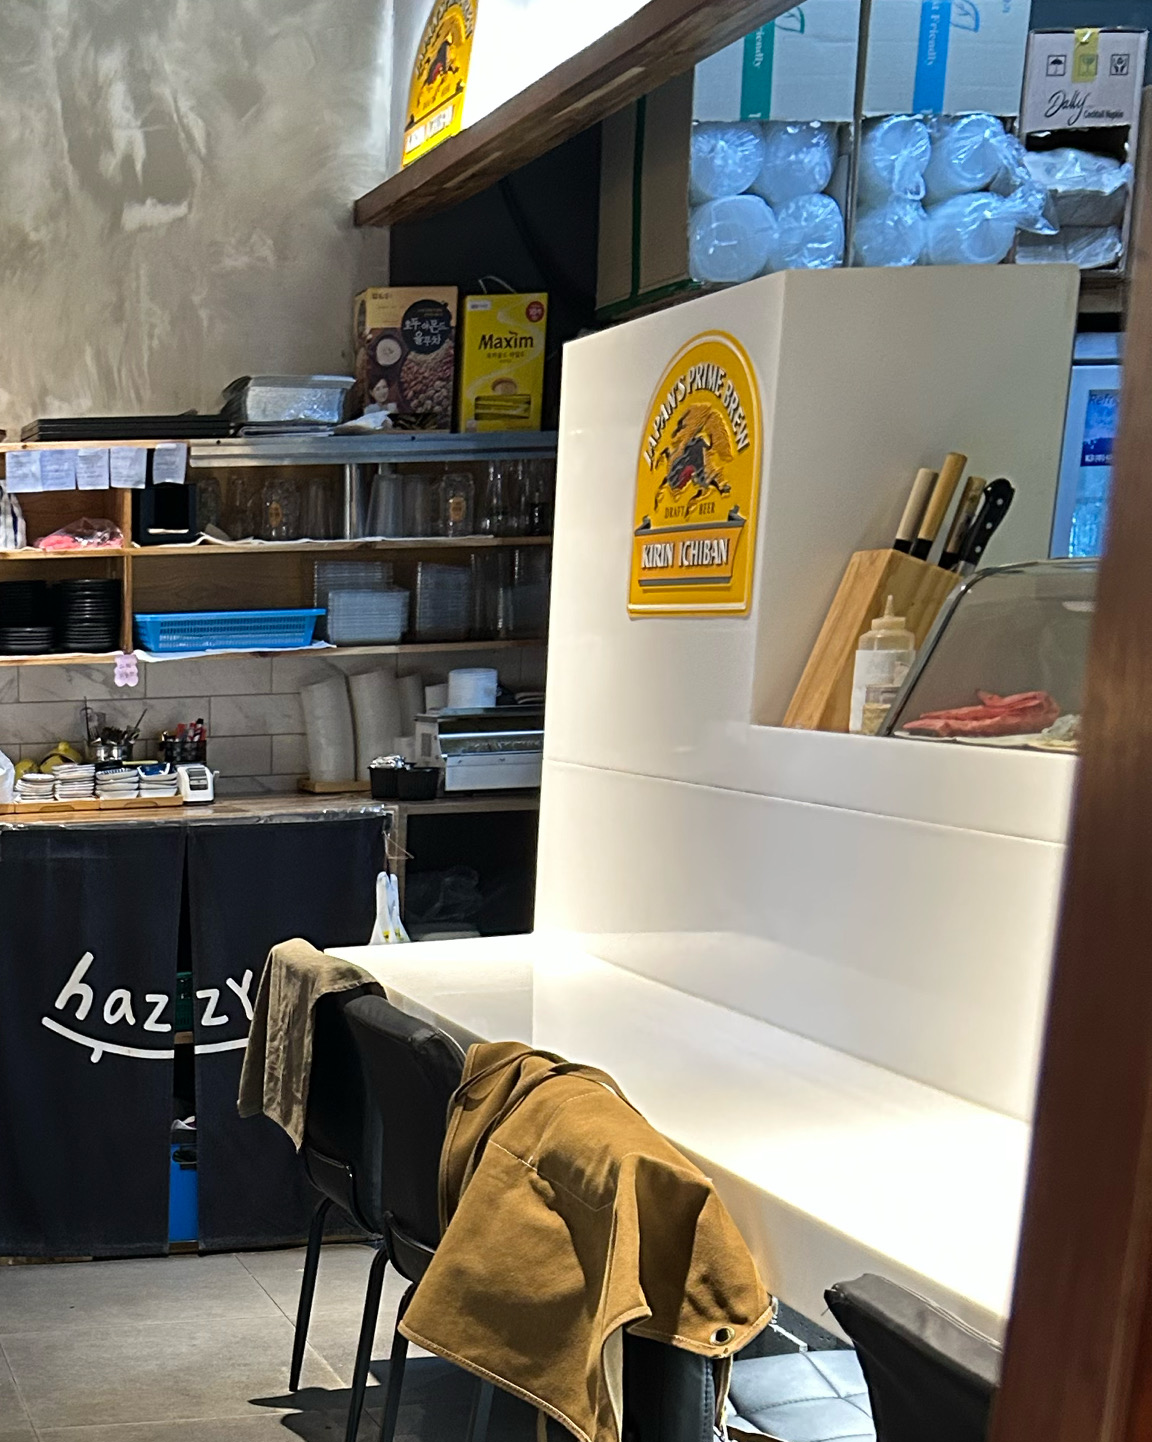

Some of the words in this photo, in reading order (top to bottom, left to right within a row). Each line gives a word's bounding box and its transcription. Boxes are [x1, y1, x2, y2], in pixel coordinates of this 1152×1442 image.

[478, 331, 535, 350] Maxim
[643, 377, 687, 470] JAPAN'S
[687, 362, 727, 399] PRIME
[720, 379, 751, 453] BREW
[664, 504, 686, 520] DRAFT
[698, 501, 716, 516] BEER
[641, 542, 676, 569] KIRIN
[678, 538, 729, 567] ICHIBAN
[54, 951, 255, 1033] hazzy
